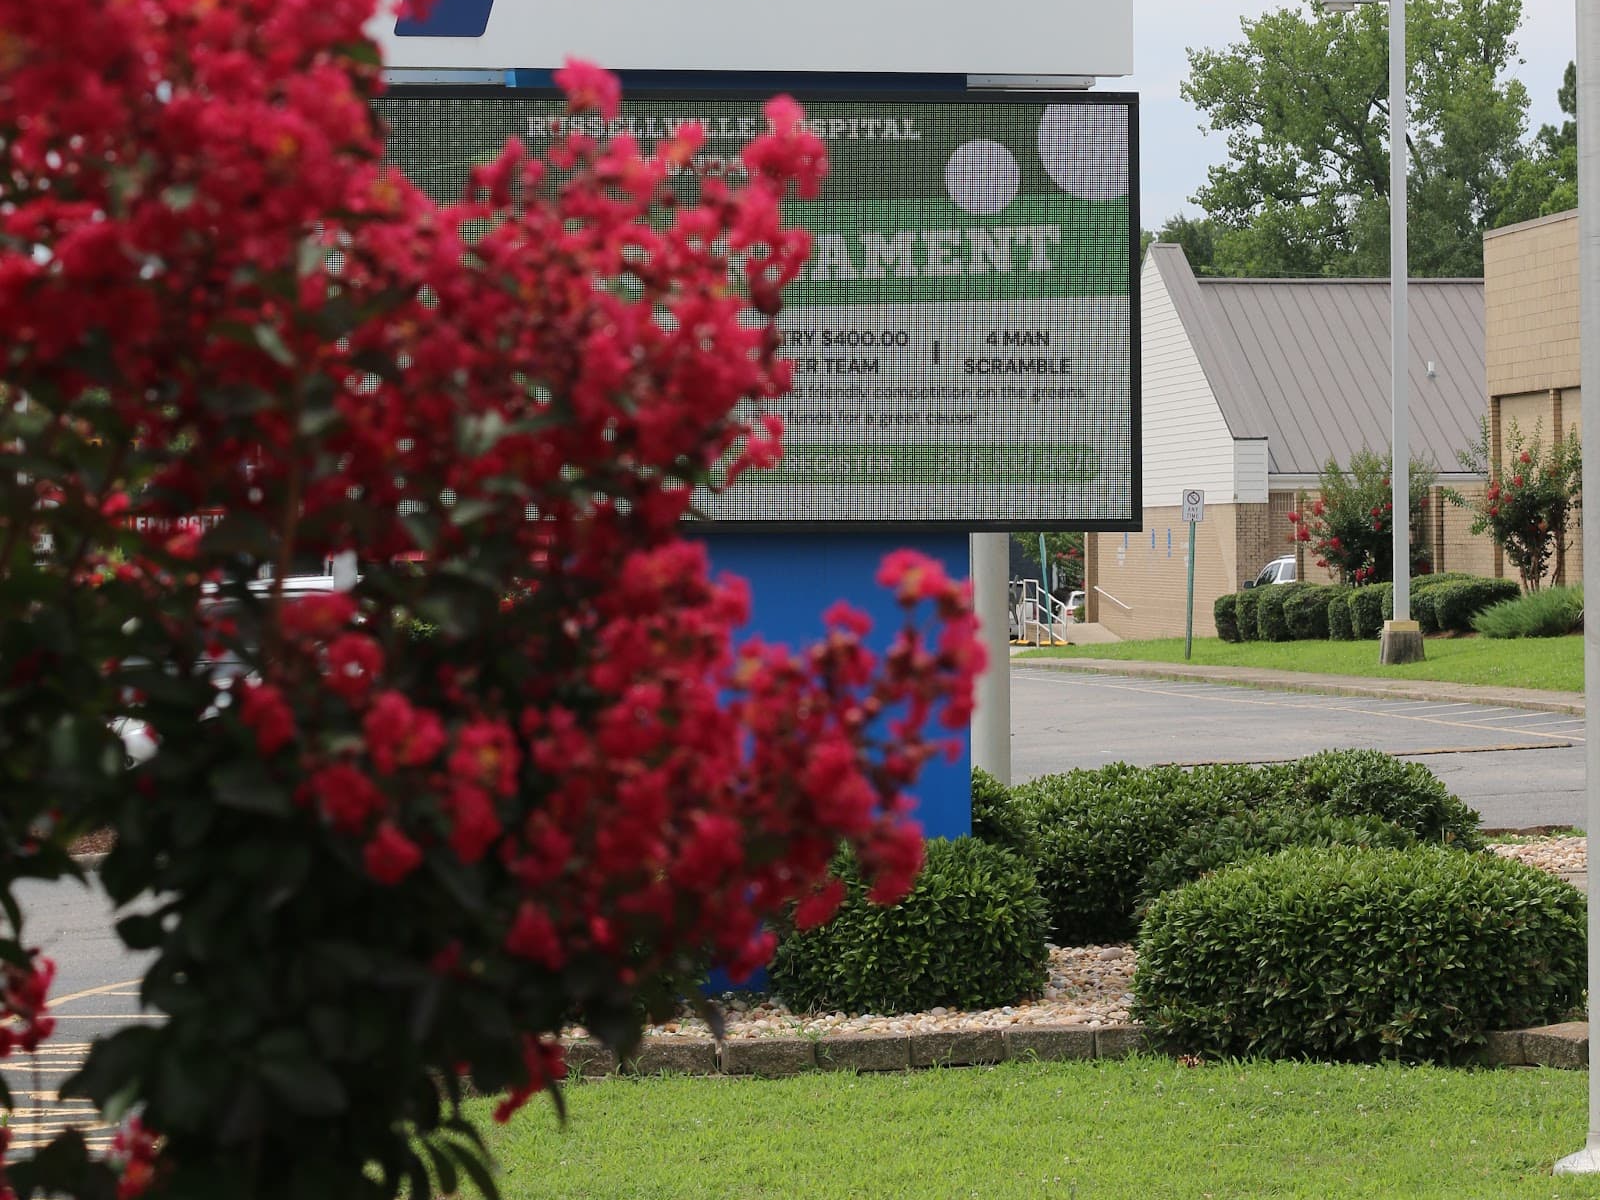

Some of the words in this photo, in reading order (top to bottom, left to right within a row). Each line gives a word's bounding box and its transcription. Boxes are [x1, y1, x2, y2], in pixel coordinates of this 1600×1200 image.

[526, 116, 756, 138] RUSSELLVLLE
[822, 329, 909, 347] $400.00
[986, 330, 998, 346] 4
[1002, 330, 1050, 346] MAN
[794, 358, 817, 374] ER
[825, 358, 880, 374] TEAM
[963, 357, 1072, 375] SCRAMBLE
[873, 385, 972, 401] competition
[976, 387, 997, 398] on
[1001, 386, 1027, 398] the
